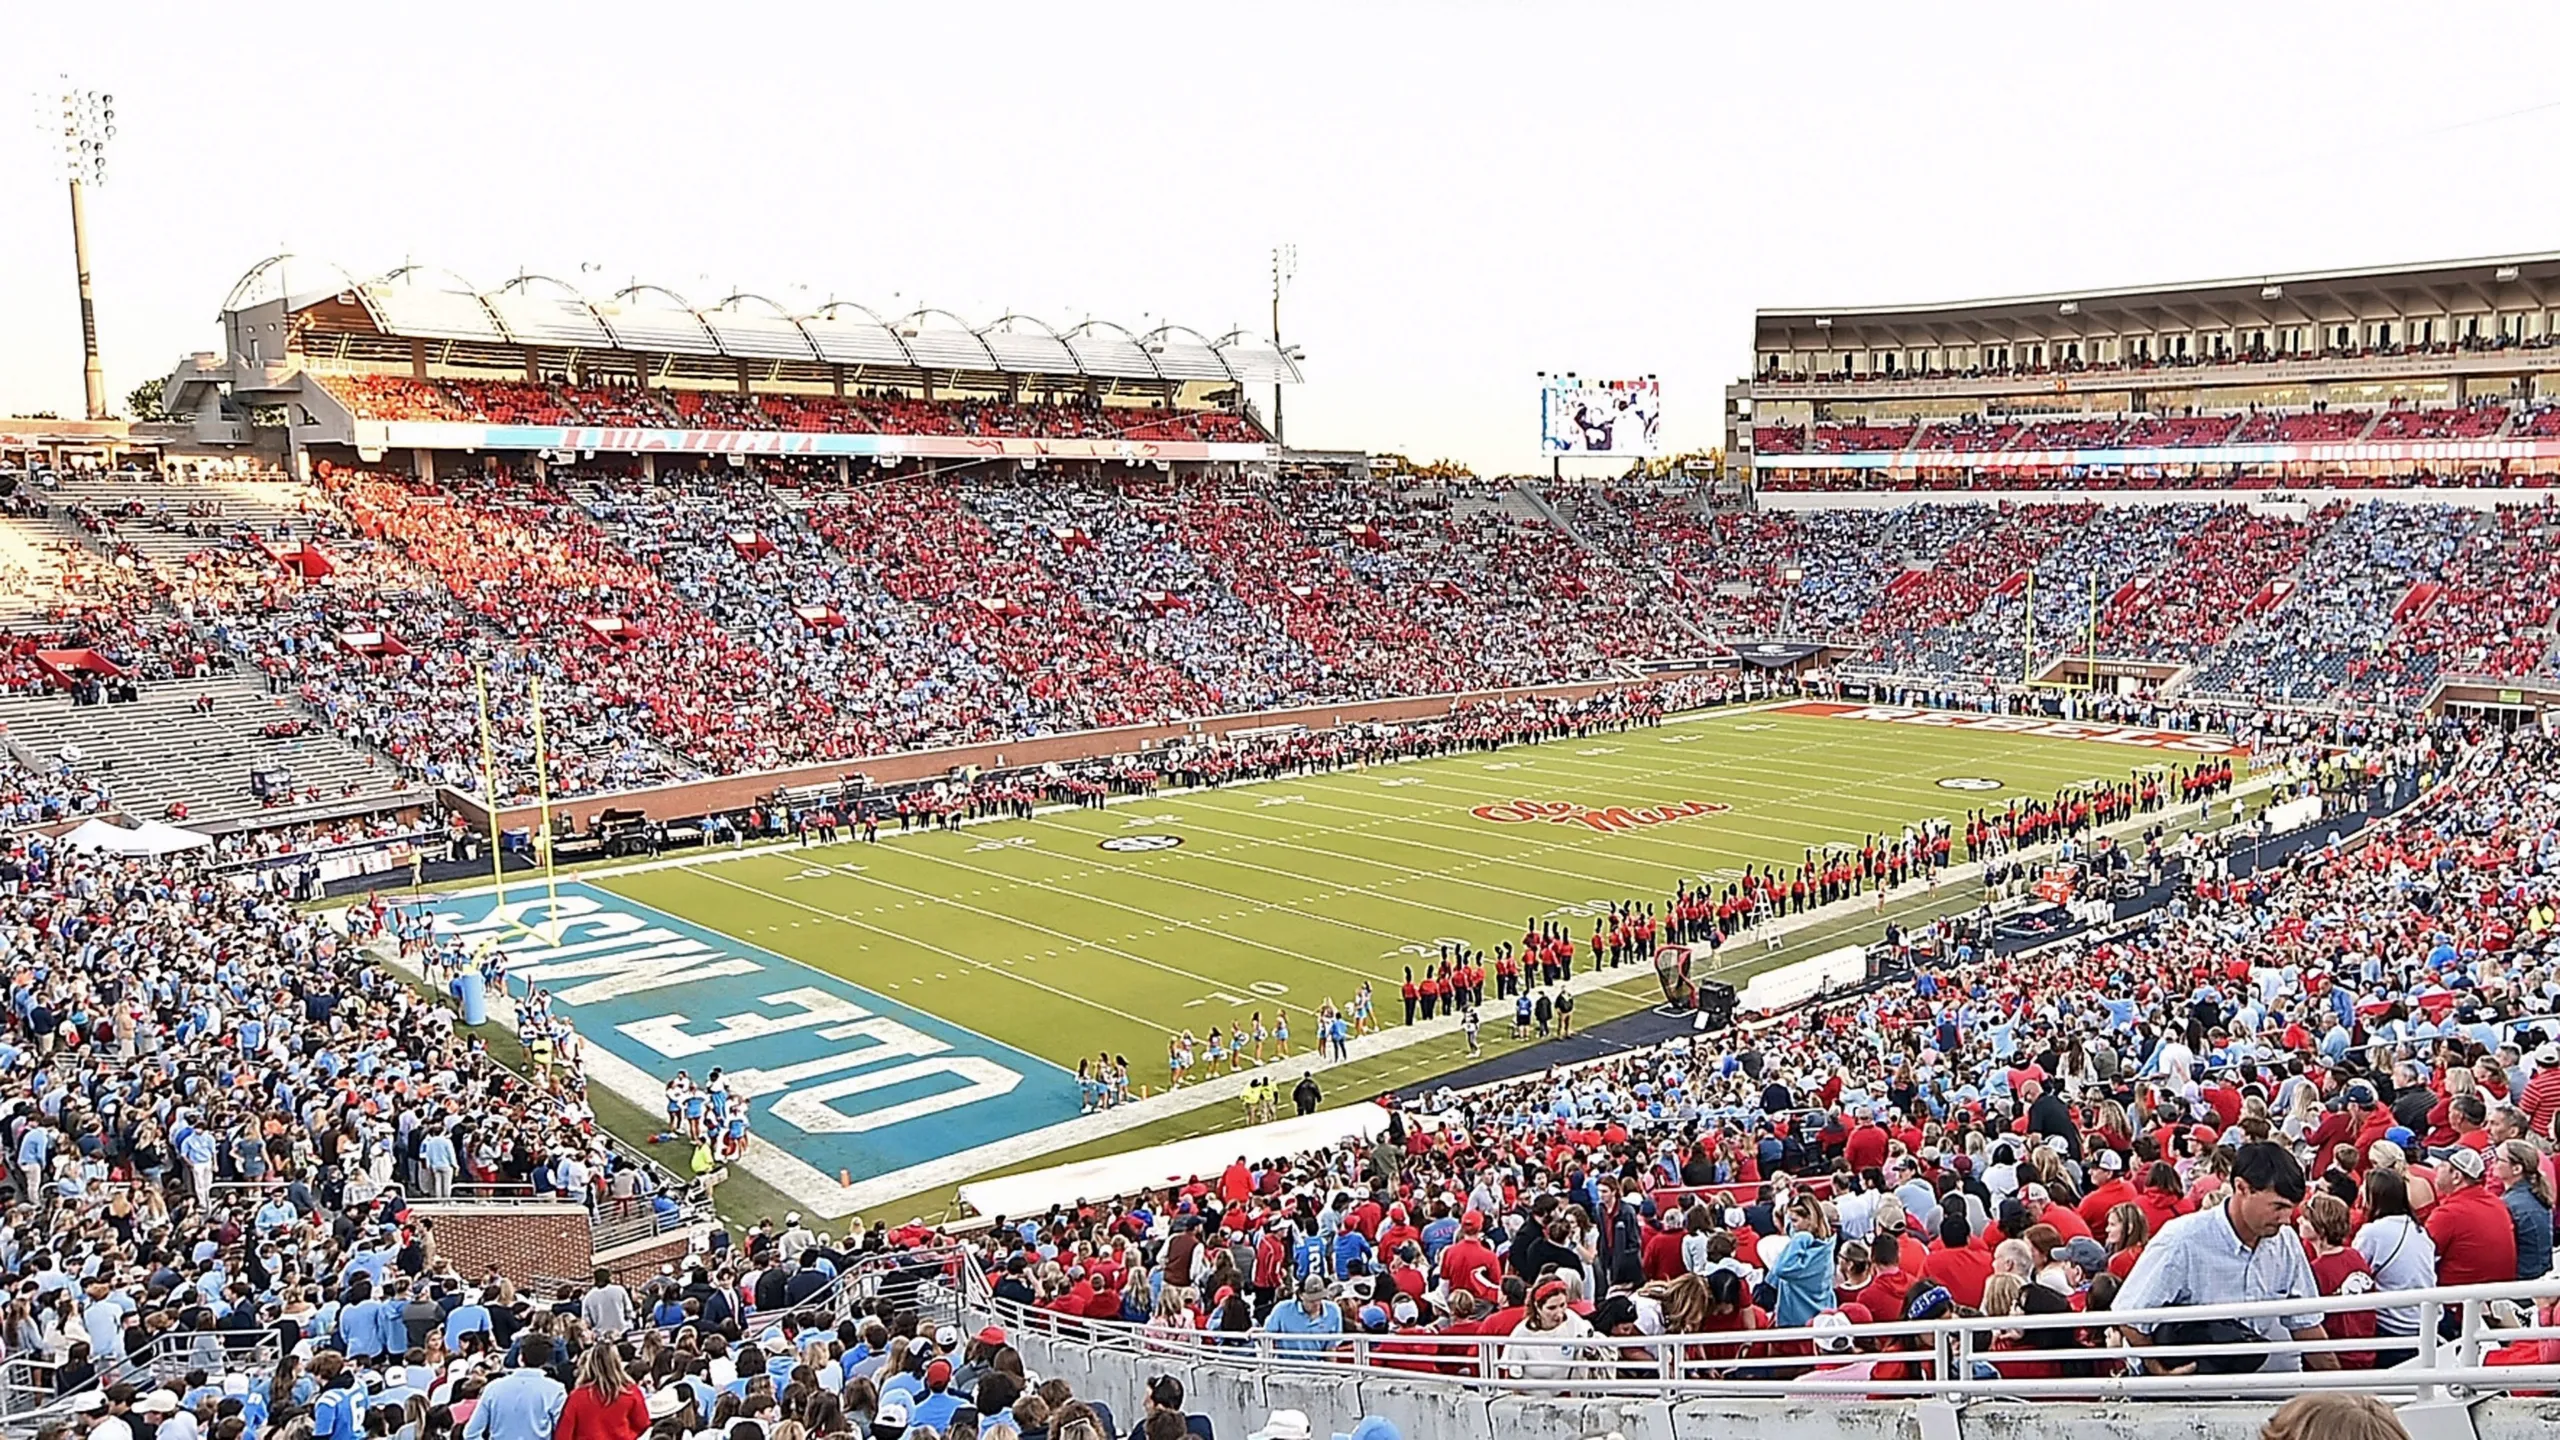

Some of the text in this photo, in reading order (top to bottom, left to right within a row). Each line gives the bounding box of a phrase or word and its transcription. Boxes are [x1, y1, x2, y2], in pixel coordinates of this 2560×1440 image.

[1832, 706, 2238, 753] REBELS
[1468, 797, 1733, 835] Ole Miss
[1204, 980, 1290, 1007] 10
[431, 894, 1026, 1135] OLE MISS
[1308, 1252, 1321, 1274] 2
